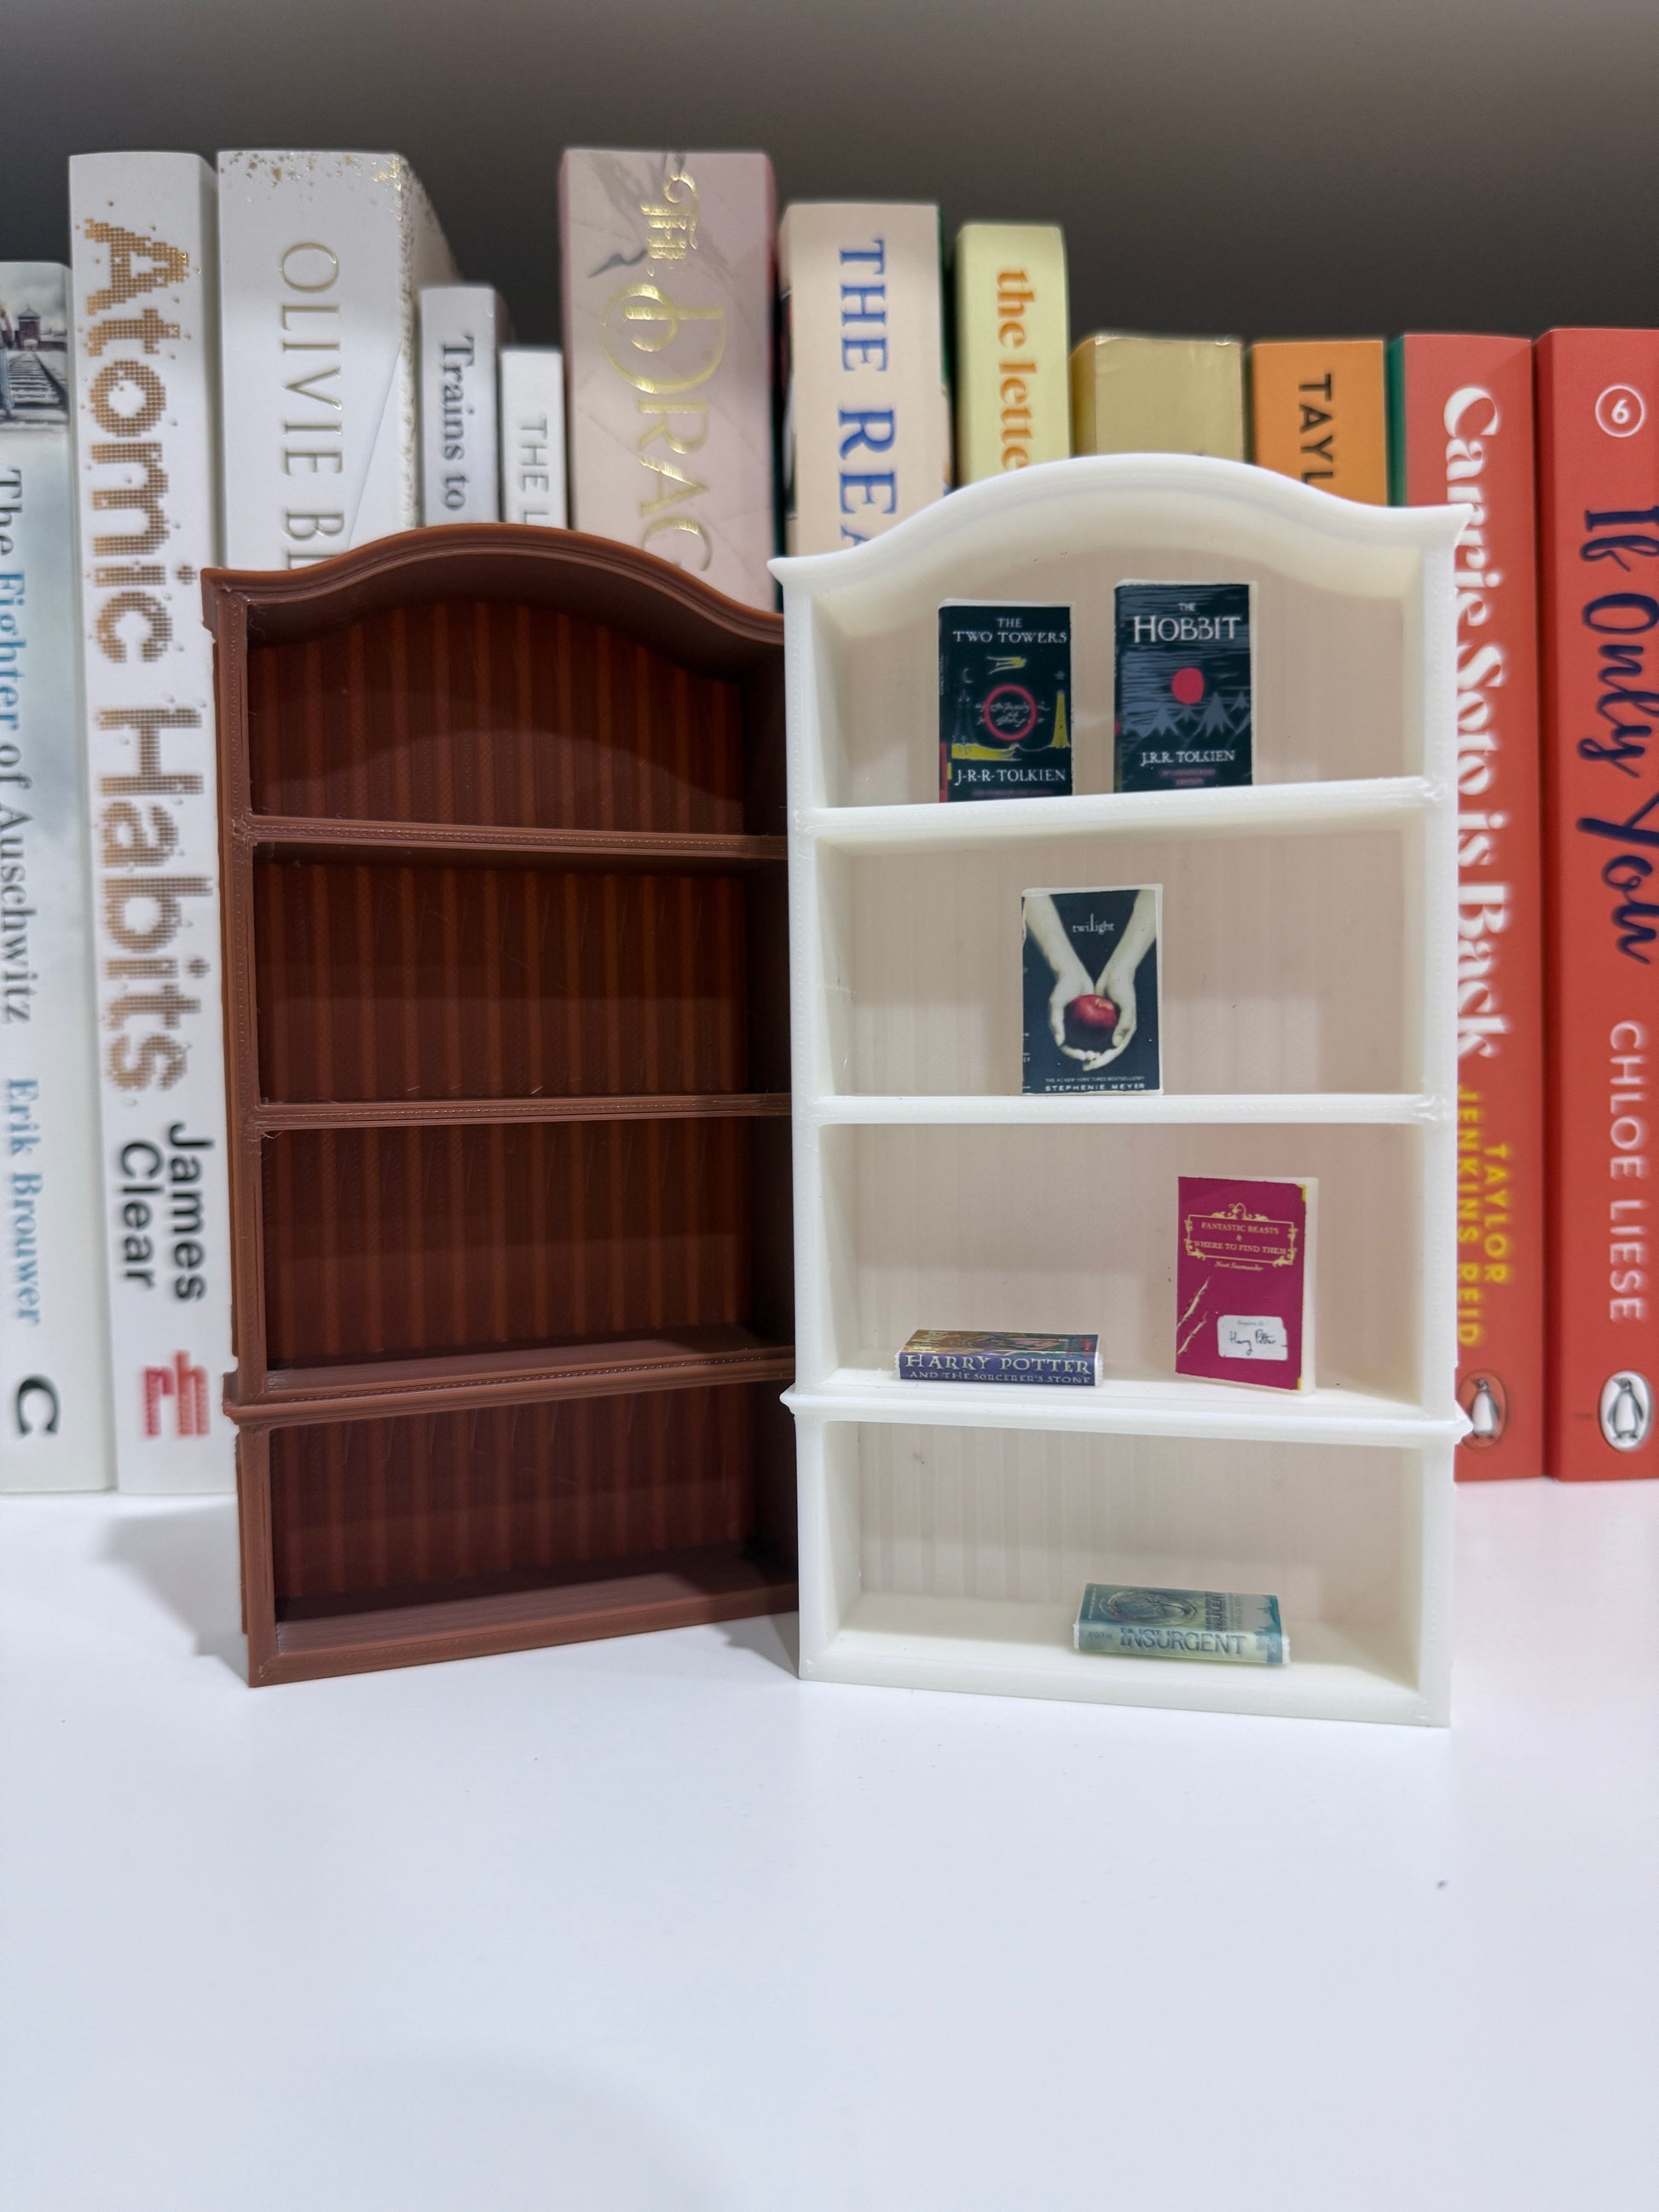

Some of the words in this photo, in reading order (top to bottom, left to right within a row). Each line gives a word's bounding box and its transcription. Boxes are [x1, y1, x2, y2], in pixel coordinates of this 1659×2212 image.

[838, 239, 887, 373] THE
[997, 268, 1037, 349] the
[281, 241, 344, 477] OLIVIE
[441, 335, 476, 465] Trains
[1610, 399, 1629, 424] 6
[84, 218, 199, 664] Atomic
[519, 413, 549, 494] THE
[443, 474, 471, 511] to
[1443, 388, 1500, 627] Carrie
[952, 631, 993, 644] TWO
[997, 631, 1067, 644] TOWERS
[997, 617, 1022, 628] THE
[1133, 615, 1241, 644] HOBBIT
[1178, 603, 1196, 611] THE
[1457, 644, 1503, 796] Soto
[1577, 592, 1659, 779] Only
[0, 744, 33, 791] of
[996, 768, 1066, 783] TOLKIEN
[1176, 749, 1235, 764] TOLKIEN
[1457, 812, 1504, 868] is
[1576, 793, 1659, 965] You
[0, 805, 39, 1022] Auschwitz
[97, 707, 214, 1091] Habits
[1072, 913, 1115, 935] twilight
[1457, 884, 1511, 1060] Back
[9, 1078, 41, 1155] Erik
[1610, 1021, 1645, 1179] CHLOE
[1457, 1083, 1481, 1245] JENKINS
[12, 1172, 43, 1325] Brouwer
[121, 1141, 165, 1288] Clear
[170, 1121, 215, 1302] James
[1201, 1222, 1246, 1233] FANTASTIC
[1247, 1225, 1279, 1234] BEASTS
[1239, 1245, 1260, 1253] FIND
[1484, 1143, 1509, 1285] TAYLOR
[1610, 1201, 1645, 1321] LIESE
[905, 1354, 991, 1371] HARRY
[999, 1357, 1092, 1375] POTTER
[910, 1371, 939, 1379] AND
[942, 1371, 970, 1380] THE
[973, 1372, 1043, 1383] SORCERER'S
[1046, 1375, 1091, 1384] STONE
[1119, 1626, 1246, 1655] INSURGENT
